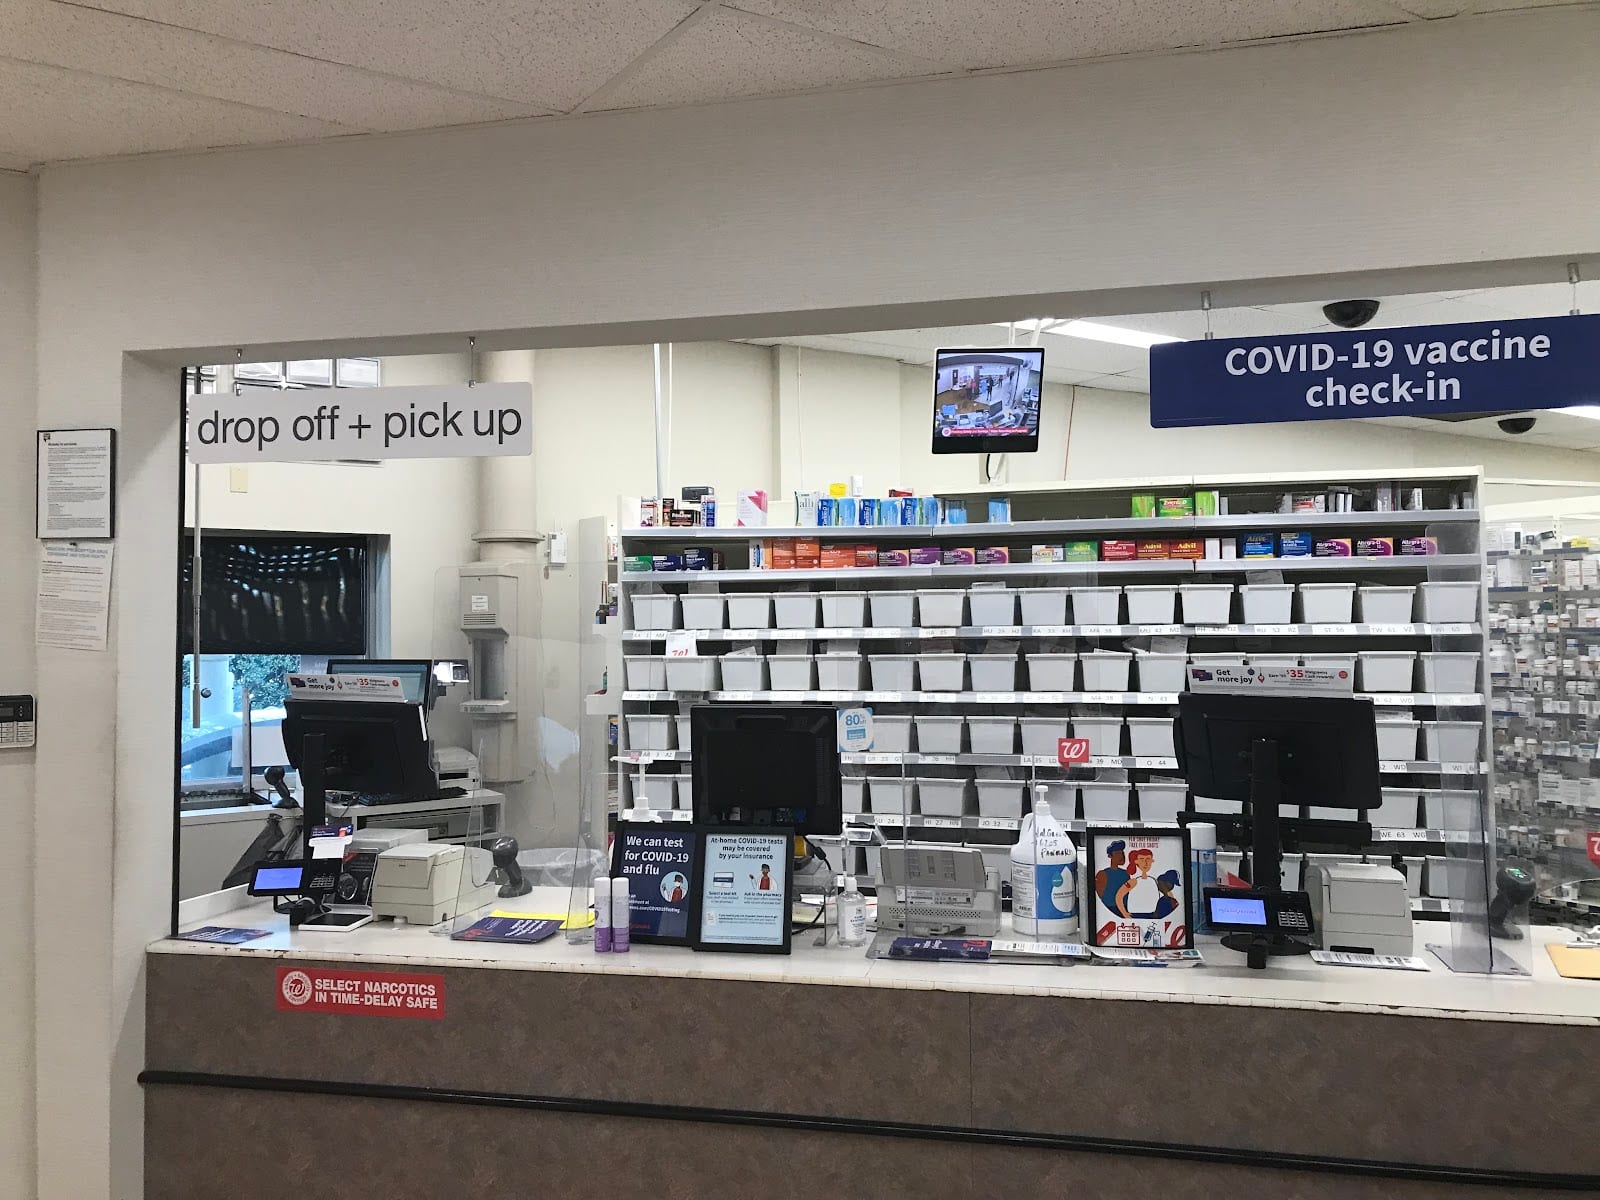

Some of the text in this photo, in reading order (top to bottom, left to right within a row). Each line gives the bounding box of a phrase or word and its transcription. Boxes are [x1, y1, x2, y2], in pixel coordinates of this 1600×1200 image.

[1225, 329, 1551, 376] COVID-19 vaccine
[1305, 370, 1460, 408] check-in
[198, 410, 280, 451] drop
[292, 405, 340, 441] off
[384, 402, 463, 447] pick
[473, 407, 522, 444] up
[800, 498, 814, 508] alli
[1240, 676, 1253, 684] joy
[626, 836, 684, 848] We can test
[624, 850, 689, 863] for COVID-19
[623, 864, 660, 875] and flu
[314, 978, 361, 992] SELECT
[364, 981, 436, 996] NARCOTICS
[315, 992, 438, 1010] IN TIME-DELAY SAFE
